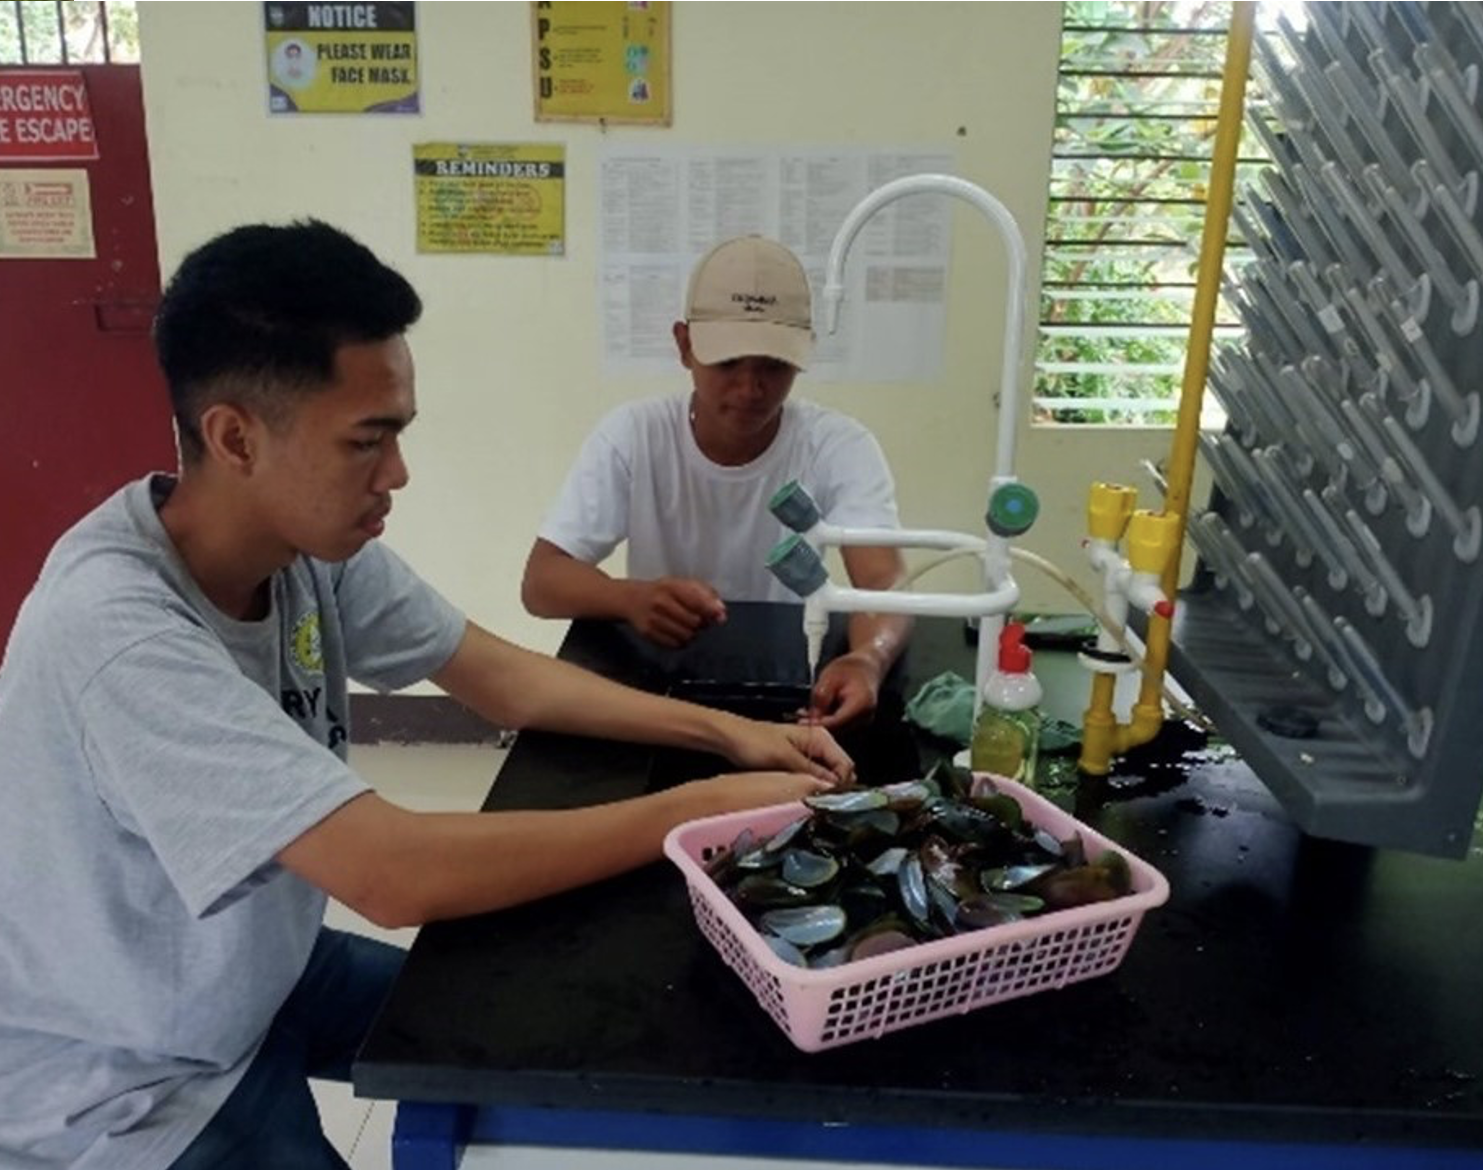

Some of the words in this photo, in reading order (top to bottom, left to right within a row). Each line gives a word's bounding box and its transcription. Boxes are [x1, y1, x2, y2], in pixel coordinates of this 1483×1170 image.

[308, 5, 377, 27] NOTICE
[317, 43, 367, 60] PLEASE
[371, 43, 411, 60] WEAR
[331, 67, 364, 84] FACE
[15, 117, 94, 143] ESCAPE
[435, 160, 551, 178] REMINDERS
